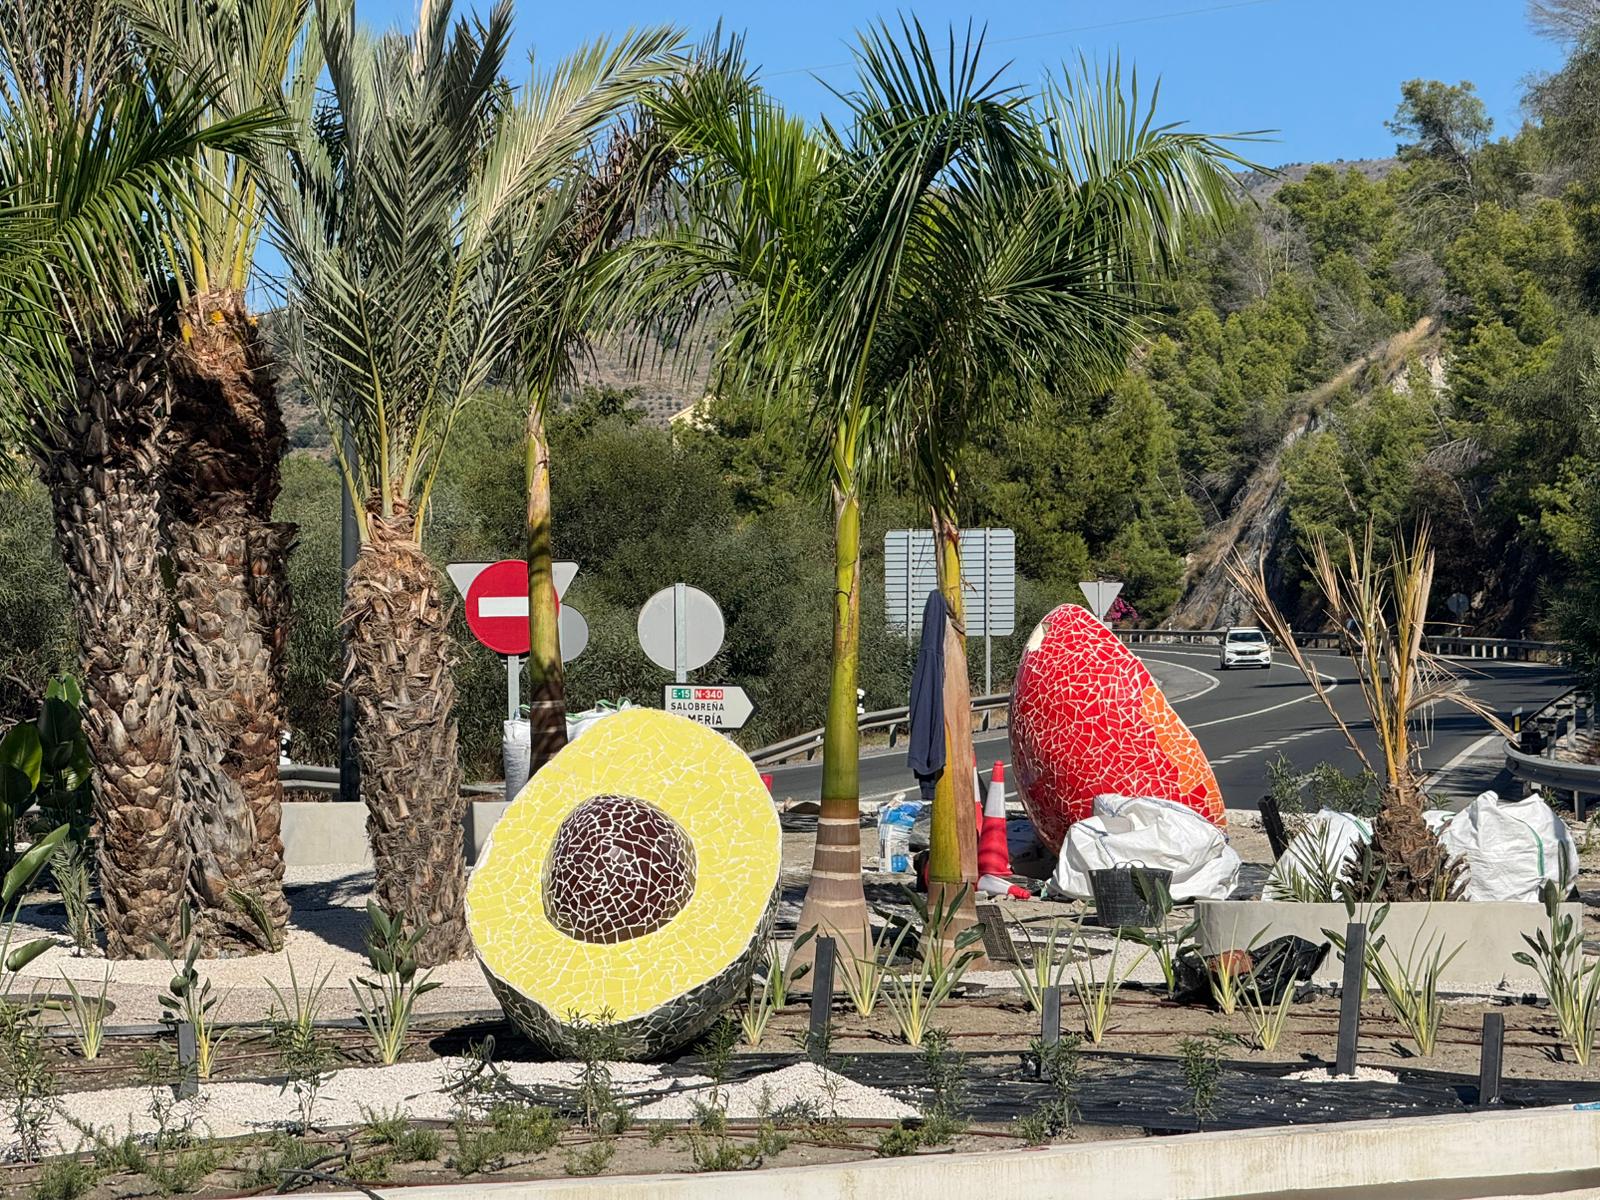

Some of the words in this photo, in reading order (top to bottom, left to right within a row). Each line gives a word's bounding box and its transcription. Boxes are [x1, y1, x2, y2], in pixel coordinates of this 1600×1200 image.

[672, 689, 690, 698] E-15
[695, 690, 723, 699] N-340
[671, 701, 724, 711] SALOBREÑA
[673, 712, 723, 725] MERÍA
